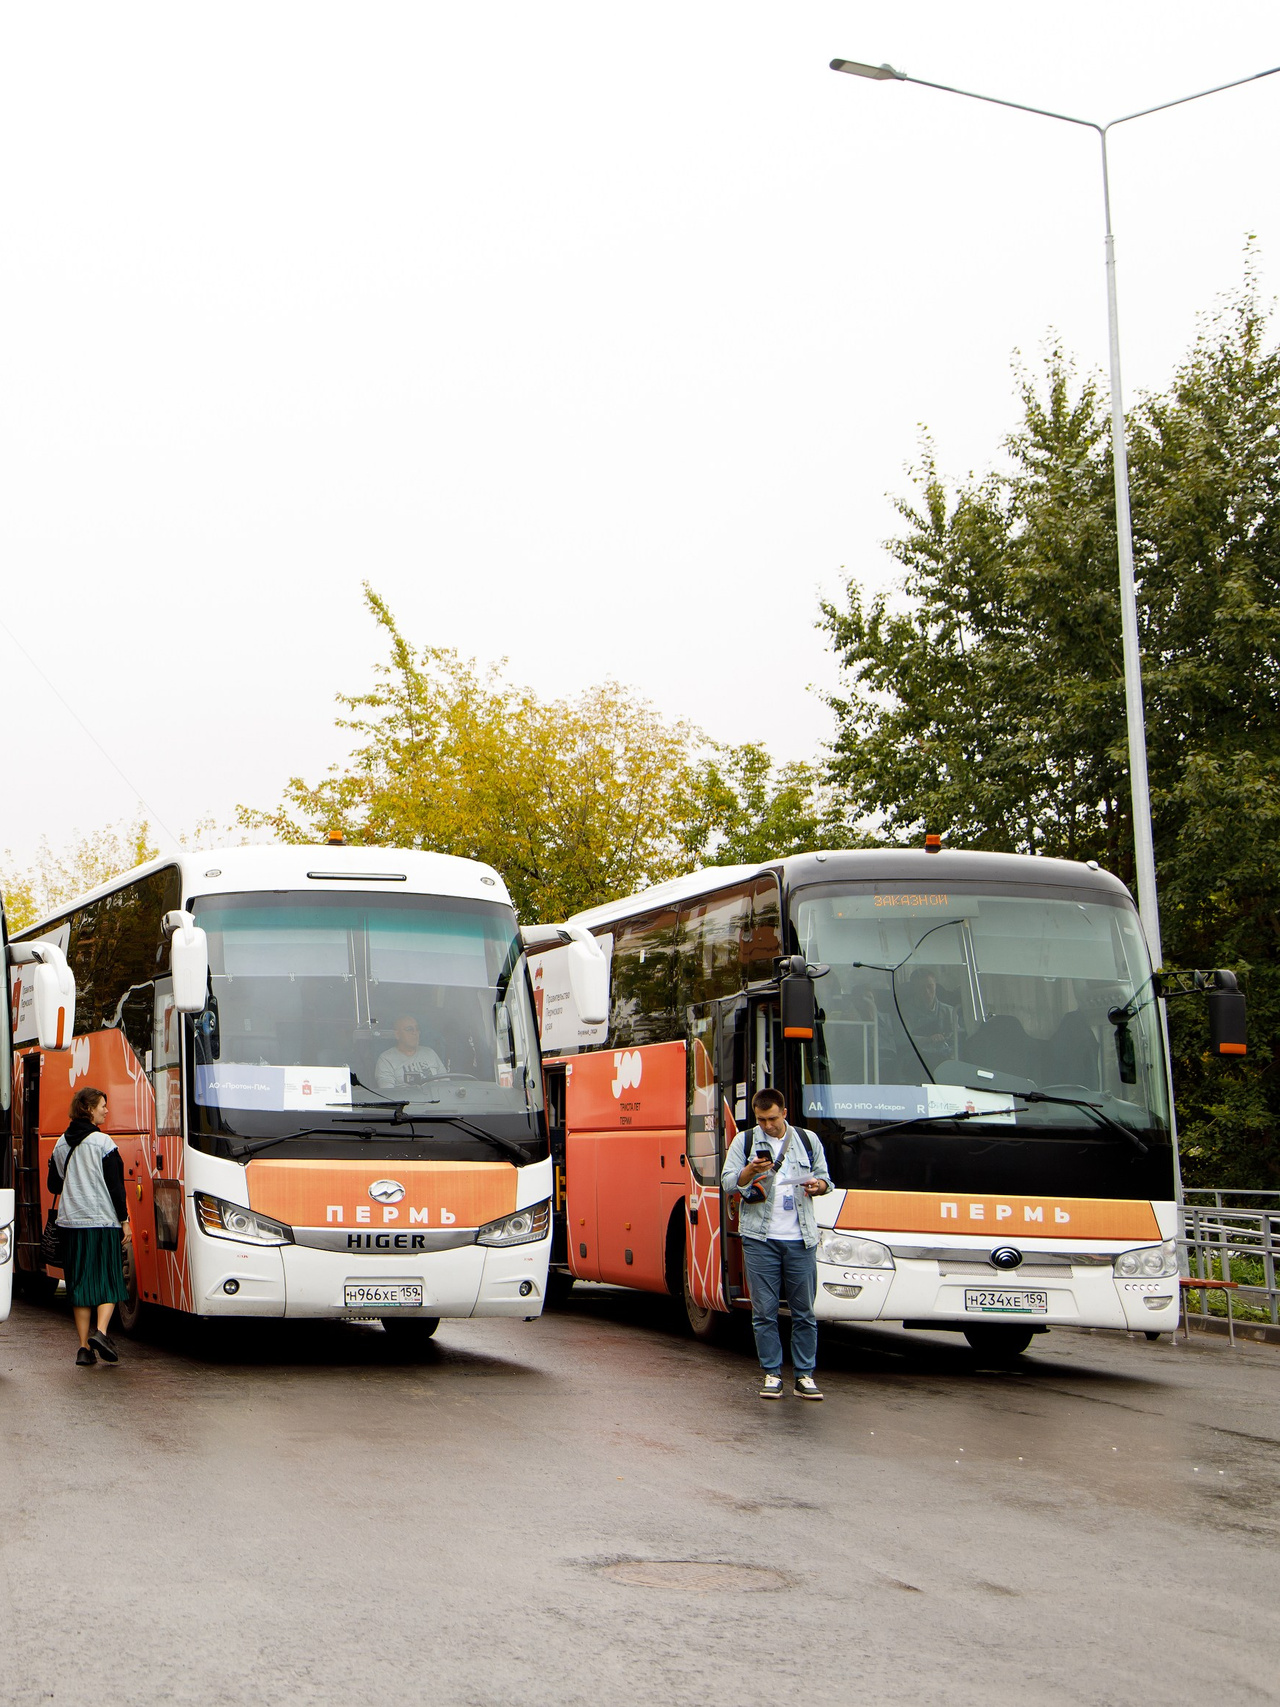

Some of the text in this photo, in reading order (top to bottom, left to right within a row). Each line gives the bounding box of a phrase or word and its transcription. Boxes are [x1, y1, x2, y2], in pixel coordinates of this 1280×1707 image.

[874, 894, 948, 906] ЗАКАЗНОЙ
[208, 1081, 271, 1091] АО «Протон-ПМ»
[834, 1102, 906, 1112] ПАО НПО «Искра»
[326, 1205, 456, 1225] ПЕРМЬ
[940, 1201, 1071, 1223] ПЕРМЬ
[347, 1234, 426, 1249] HIGER
[400, 1287, 418, 1298] 159
[1024, 1293, 1043, 1304] 159
